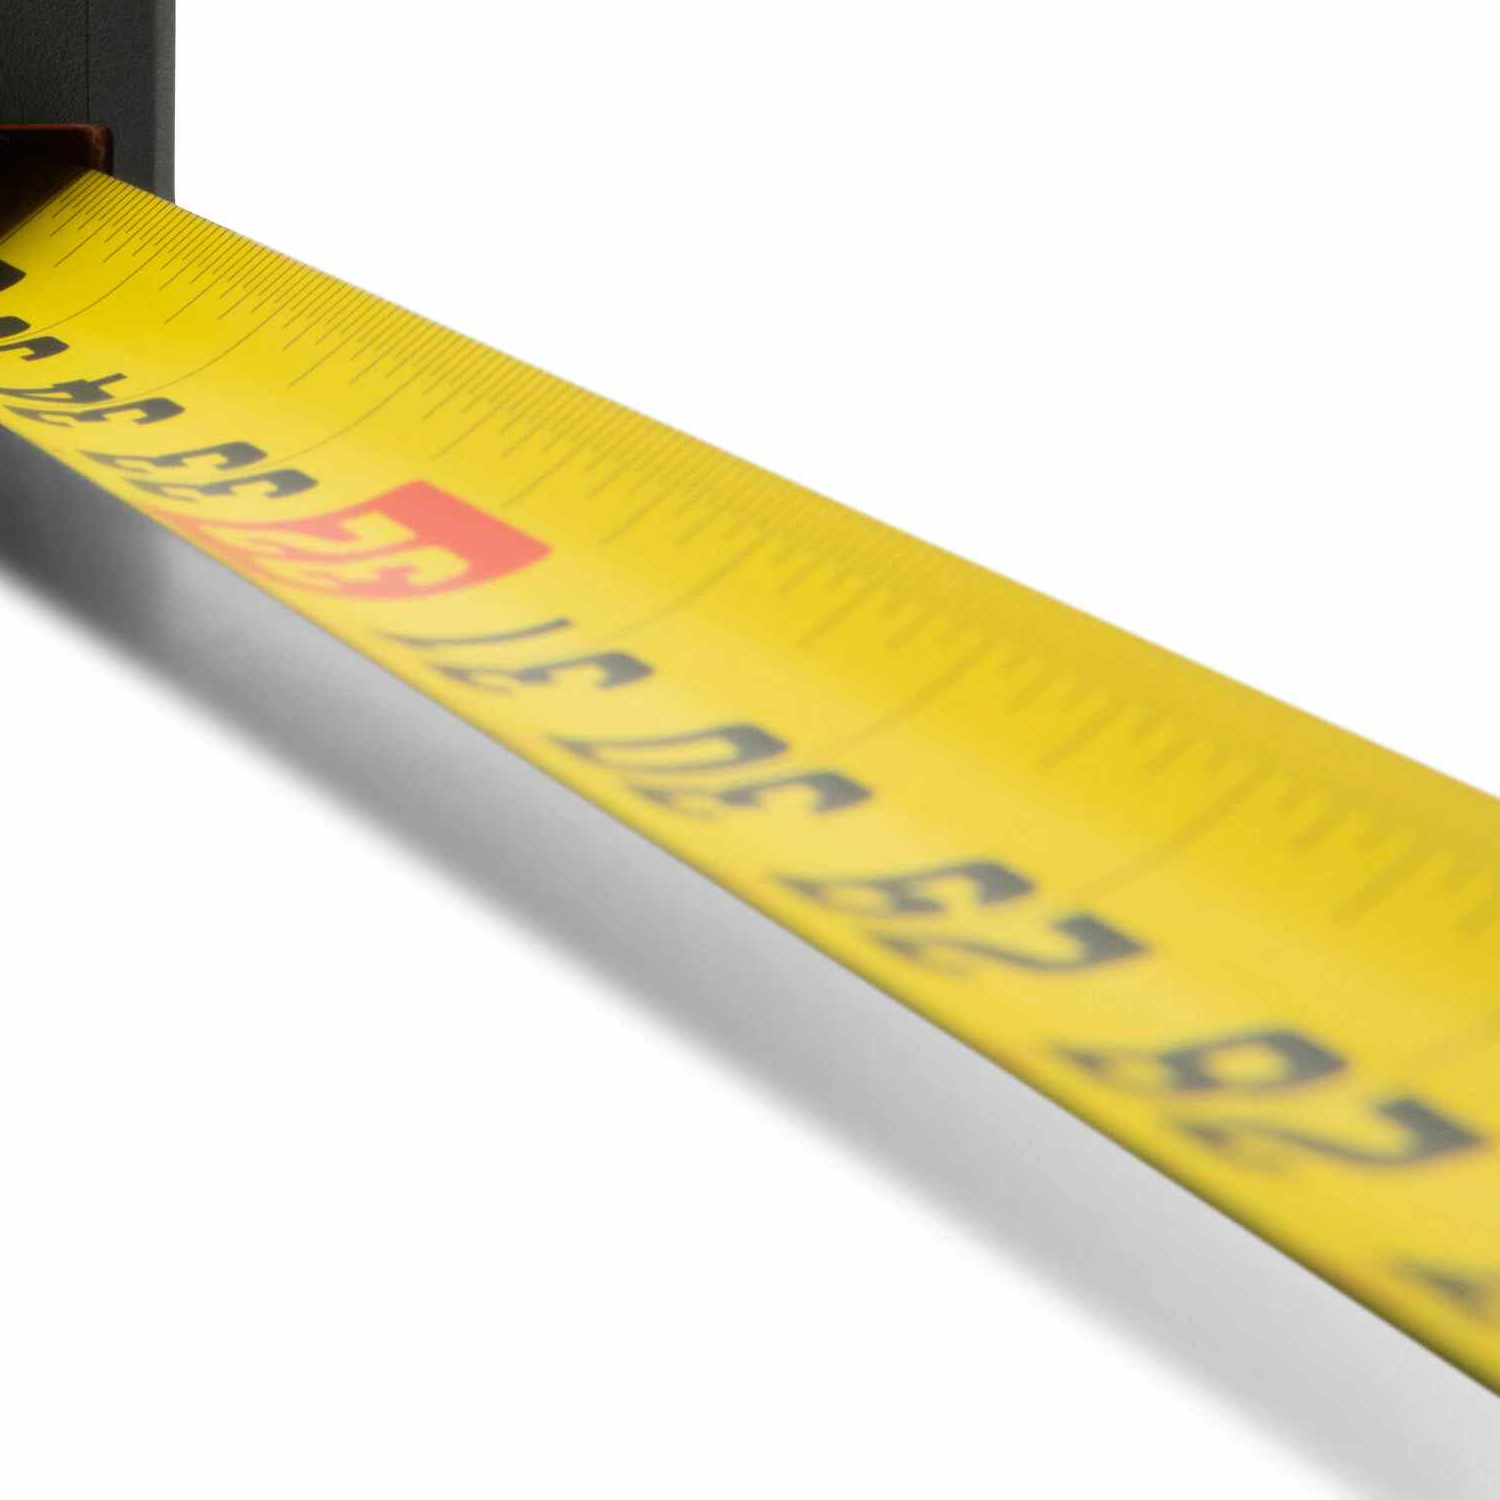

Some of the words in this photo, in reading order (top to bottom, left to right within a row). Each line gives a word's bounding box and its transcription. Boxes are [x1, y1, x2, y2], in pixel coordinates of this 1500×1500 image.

[76, 440, 319, 502] 33
[195, 510, 472, 592] 32
[370, 616, 656, 696] 31
[545, 723, 874, 820] 30
[762, 858, 1154, 976] 29
[1040, 1028, 1492, 1174] 28
